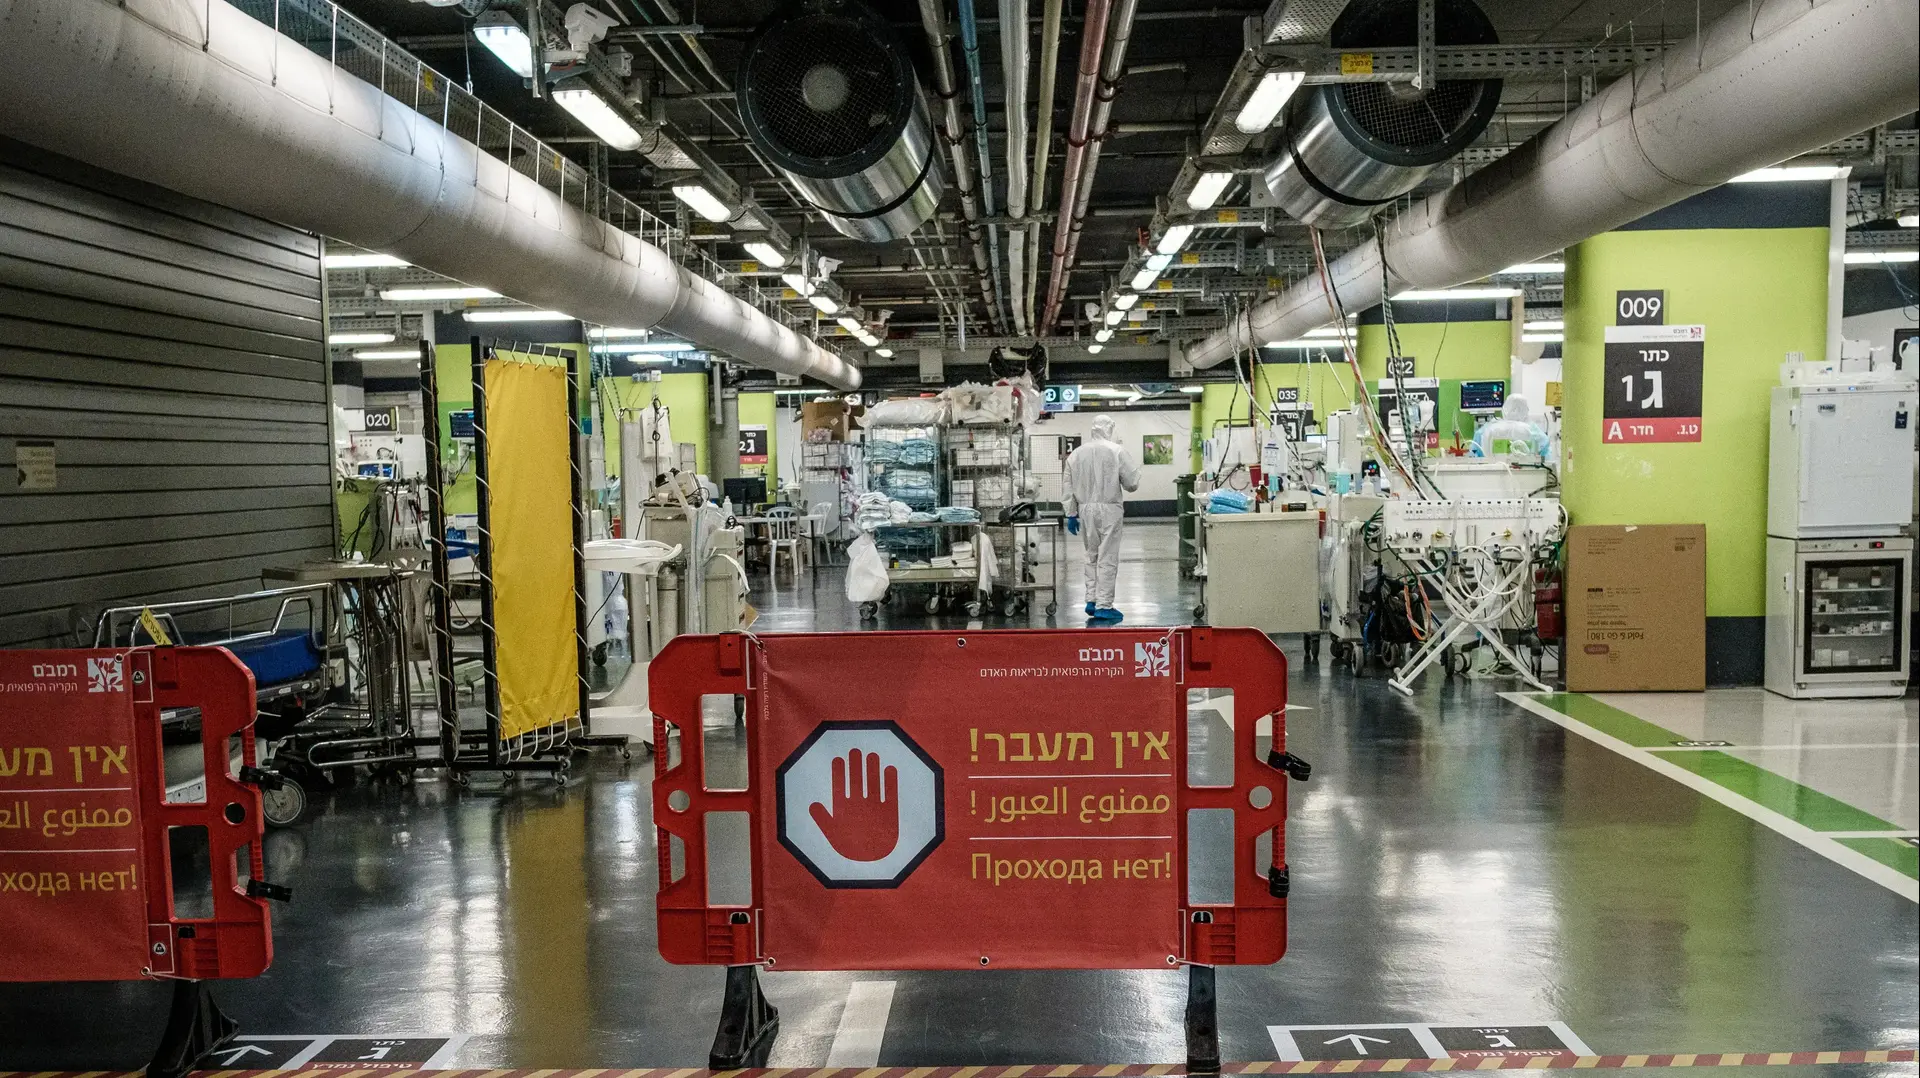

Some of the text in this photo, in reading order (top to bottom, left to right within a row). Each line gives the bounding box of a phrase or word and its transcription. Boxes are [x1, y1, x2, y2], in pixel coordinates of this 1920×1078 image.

[1620, 296, 1661, 318] 009
[1638, 349, 1670, 362] כתר
[1278, 390, 1297, 400] 035
[366, 413, 390, 427] 020
[1607, 421, 1623, 440] A
[1629, 425, 1655, 436] חדר
[1590, 631, 1644, 641] Fold & Go 180
[980, 665, 1124, 678] הקריה הרפואית לבריאות האדם
[7, 682, 47, 693] הרפואית
[49, 681, 78, 693] הקריה
[969, 728, 1171, 769] אין מעבר!
[69, 744, 129, 783] אין
[984, 786, 1068, 824] العبور
[1079, 788, 1171, 824] ممنوع
[43, 801, 132, 838] ممنوع
[971, 852, 1171, 886] Прохода нет!
[0, 865, 138, 897] хода нет!
[1484, 1034, 1517, 1048] ג
[357, 1047, 392, 1060] ג
